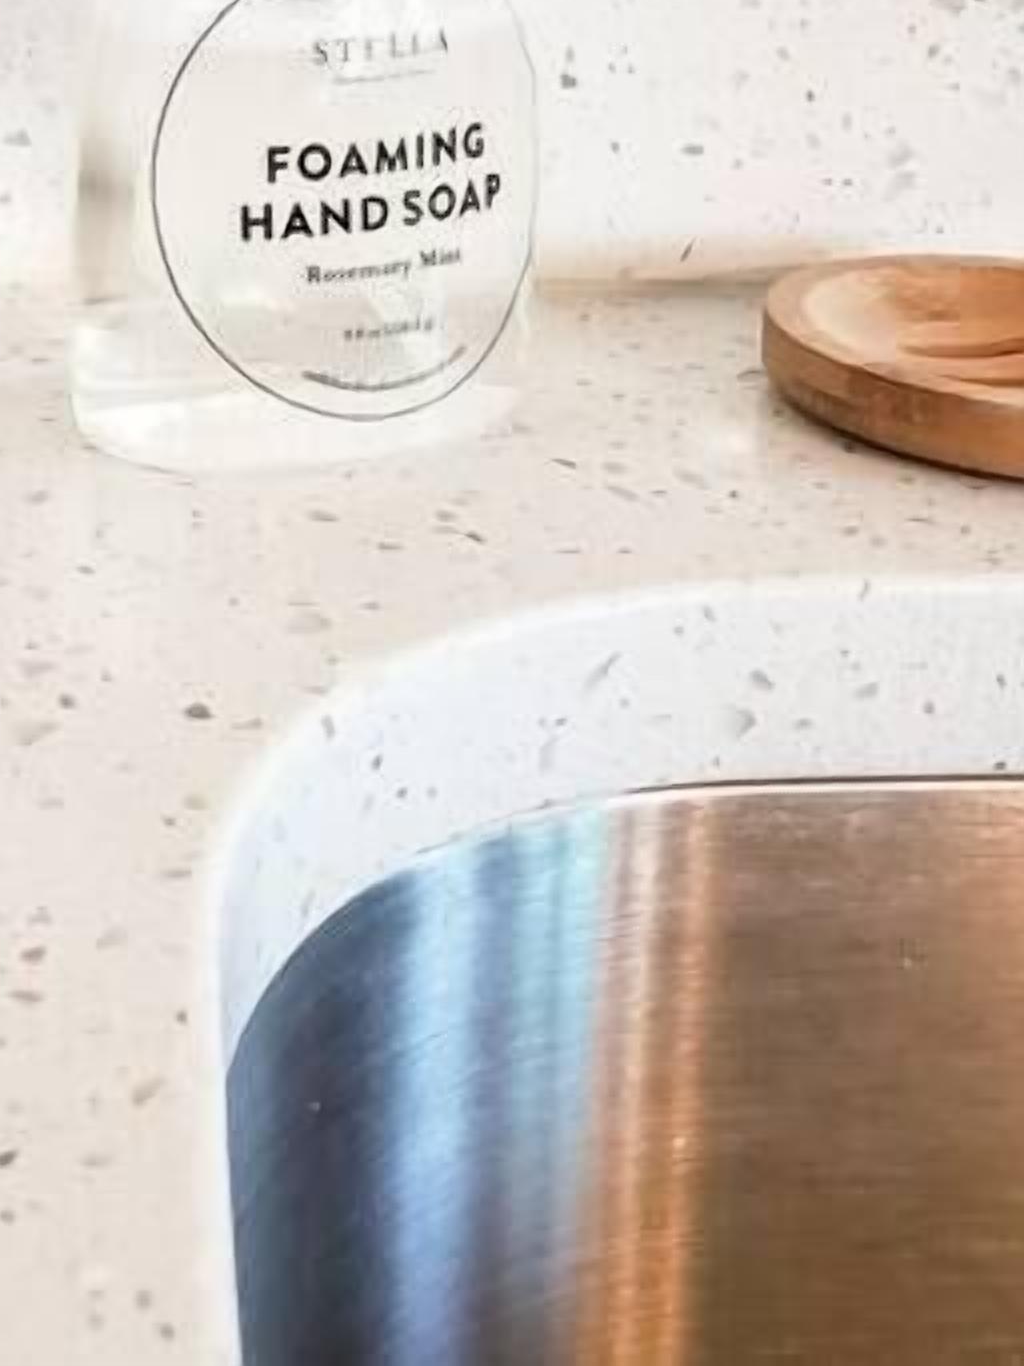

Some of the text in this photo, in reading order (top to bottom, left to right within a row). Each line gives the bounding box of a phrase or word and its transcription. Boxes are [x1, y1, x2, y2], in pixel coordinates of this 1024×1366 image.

[266, 121, 485, 184] FOAMING
[240, 172, 501, 242] HAND SOAP
